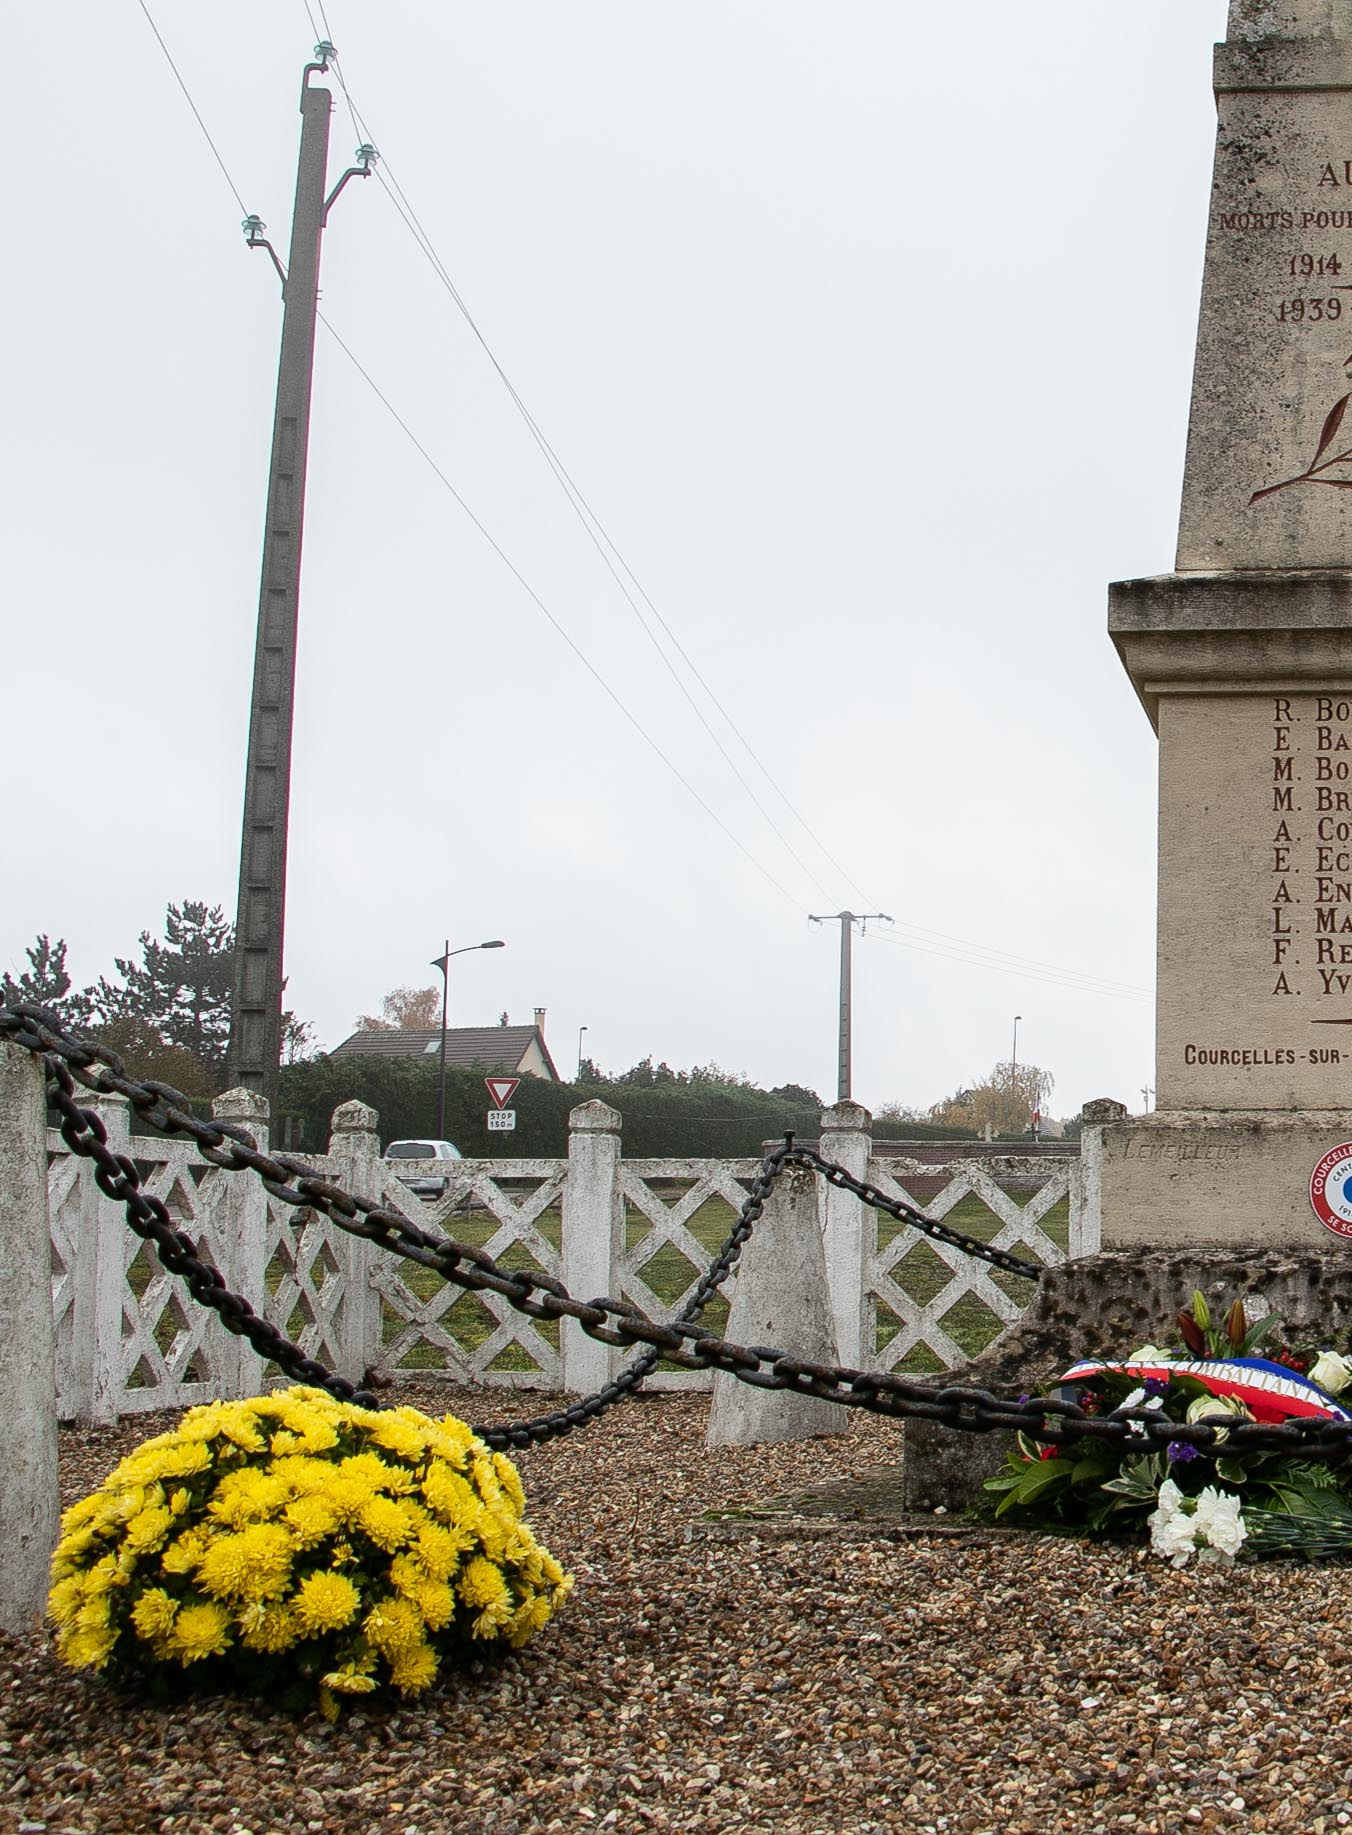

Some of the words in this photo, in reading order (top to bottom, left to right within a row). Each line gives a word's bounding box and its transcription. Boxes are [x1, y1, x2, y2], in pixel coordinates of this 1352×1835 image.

[1218, 212, 1294, 230] MORTS
[1273, 698, 1301, 722] R.
[1273, 726, 1301, 752] E.
[1272, 756, 1302, 782] M.
[1272, 786, 1302, 812] M.
[1272, 819, 1302, 843] A.
[1272, 847, 1300, 873] E.
[1272, 879, 1301, 904] A.
[1272, 907, 1301, 934] L.
[1272, 938, 1300, 965] F.
[1272, 970, 1302, 995] A.
[490, 1112, 513, 1120] STOP
[1327, 1215, 1339, 1227] SE
